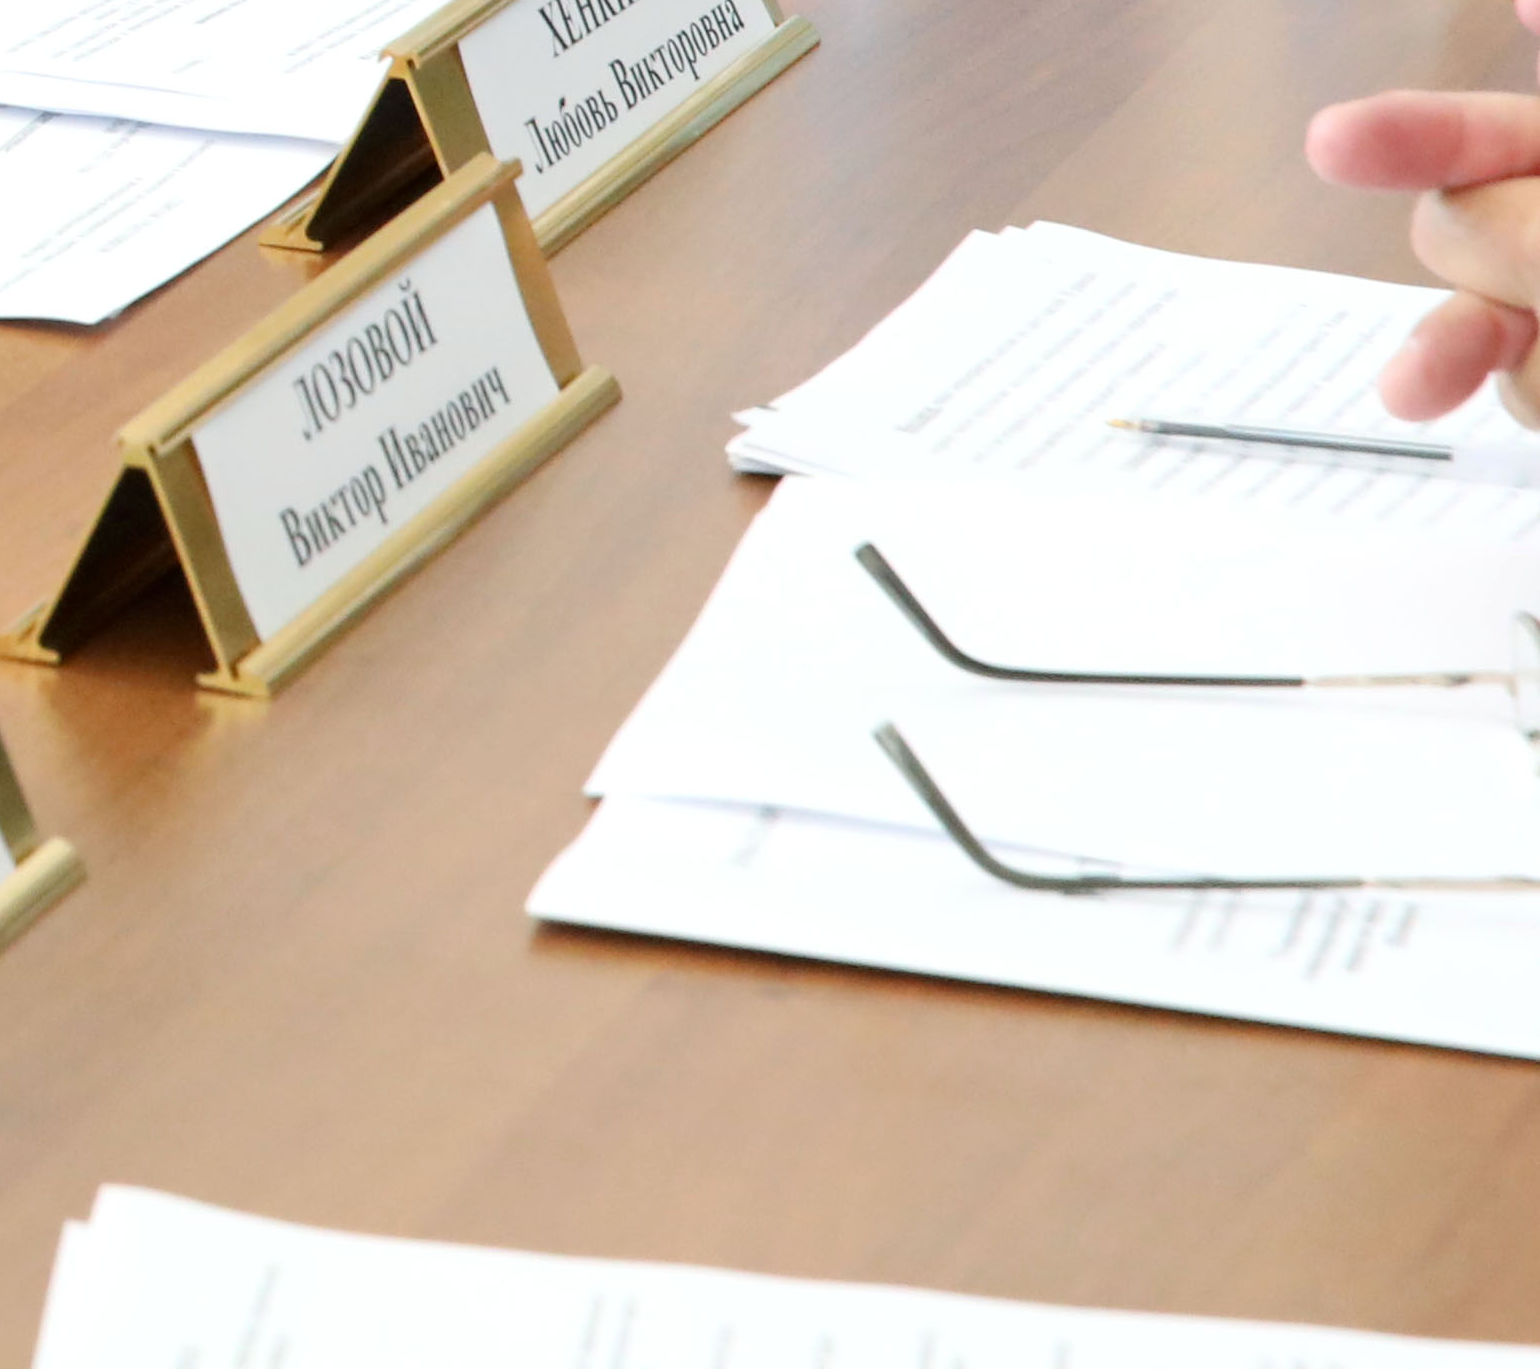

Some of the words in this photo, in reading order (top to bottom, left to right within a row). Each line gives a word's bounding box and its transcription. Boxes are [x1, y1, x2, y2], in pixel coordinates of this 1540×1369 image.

[524, 89, 619, 174] Любовь
[293, 277, 438, 441] ЛОЗОВОЙ
[279, 464, 389, 568] Виктор
[377, 365, 511, 491] Иванович
